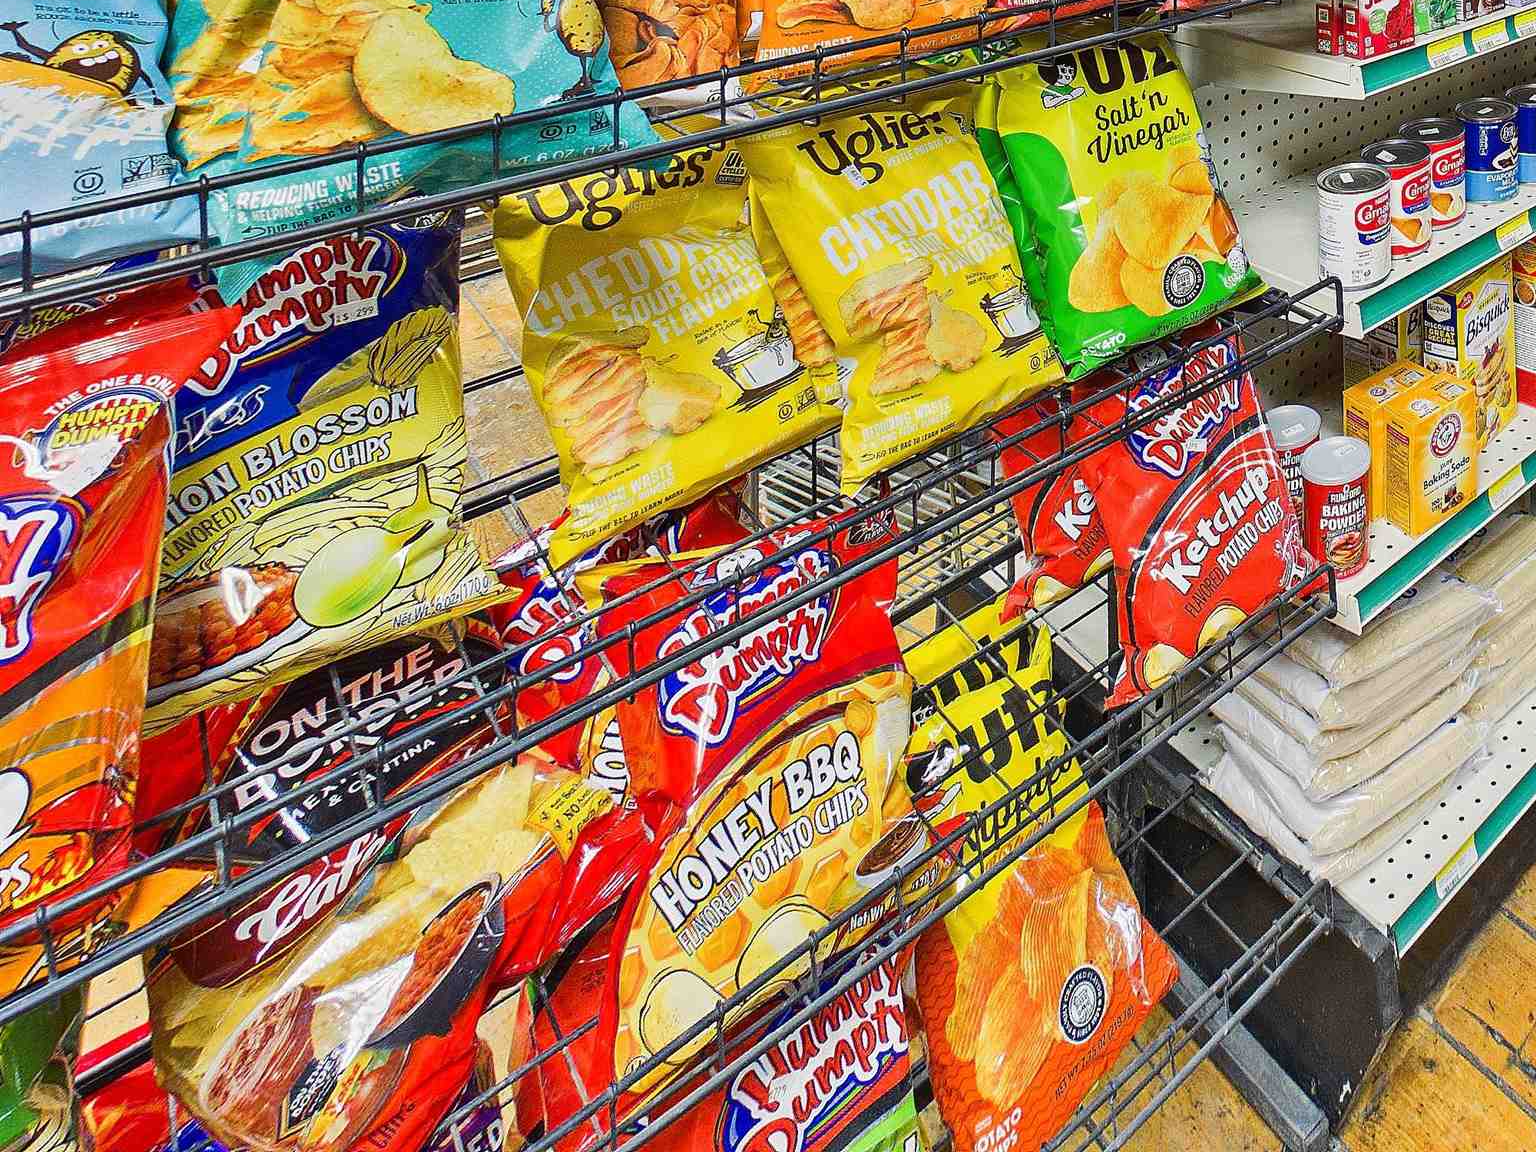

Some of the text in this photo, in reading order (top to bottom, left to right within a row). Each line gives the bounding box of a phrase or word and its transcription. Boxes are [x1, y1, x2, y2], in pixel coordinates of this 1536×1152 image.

[1088, 108, 1190, 164] Vinegar
[1095, 99, 1142, 132] Salt
[236, 179, 328, 210] REDUCING
[819, 159, 991, 277] CHEDDAR
[291, 219, 310, 231] THE
[610, 279, 684, 333] SOUR
[1424, 320, 1456, 333] DISCOVER
[1428, 327, 1456, 339] GREAT
[1466, 291, 1510, 347] Bisquick
[1427, 334, 1456, 345] RECIPES
[44, 373, 143, 418] THE ONE &
[58, 401, 162, 430] HUMPTY
[243, 385, 418, 480] BLOSSOM
[162, 432, 393, 568] FLAVORED POTATO CHIPS
[1423, 456, 1470, 490] Baking Soda
[1159, 466, 1270, 595] Ketchup
[1321, 497, 1367, 517] BAKING
[1183, 496, 1285, 617] FLAVORED POTATO CHIPS
[251, 641, 435, 755] ON THE
[650, 730, 862, 933] HONEY BBQ
[677, 778, 871, 958] FLAVORED POTATO CHIPS
